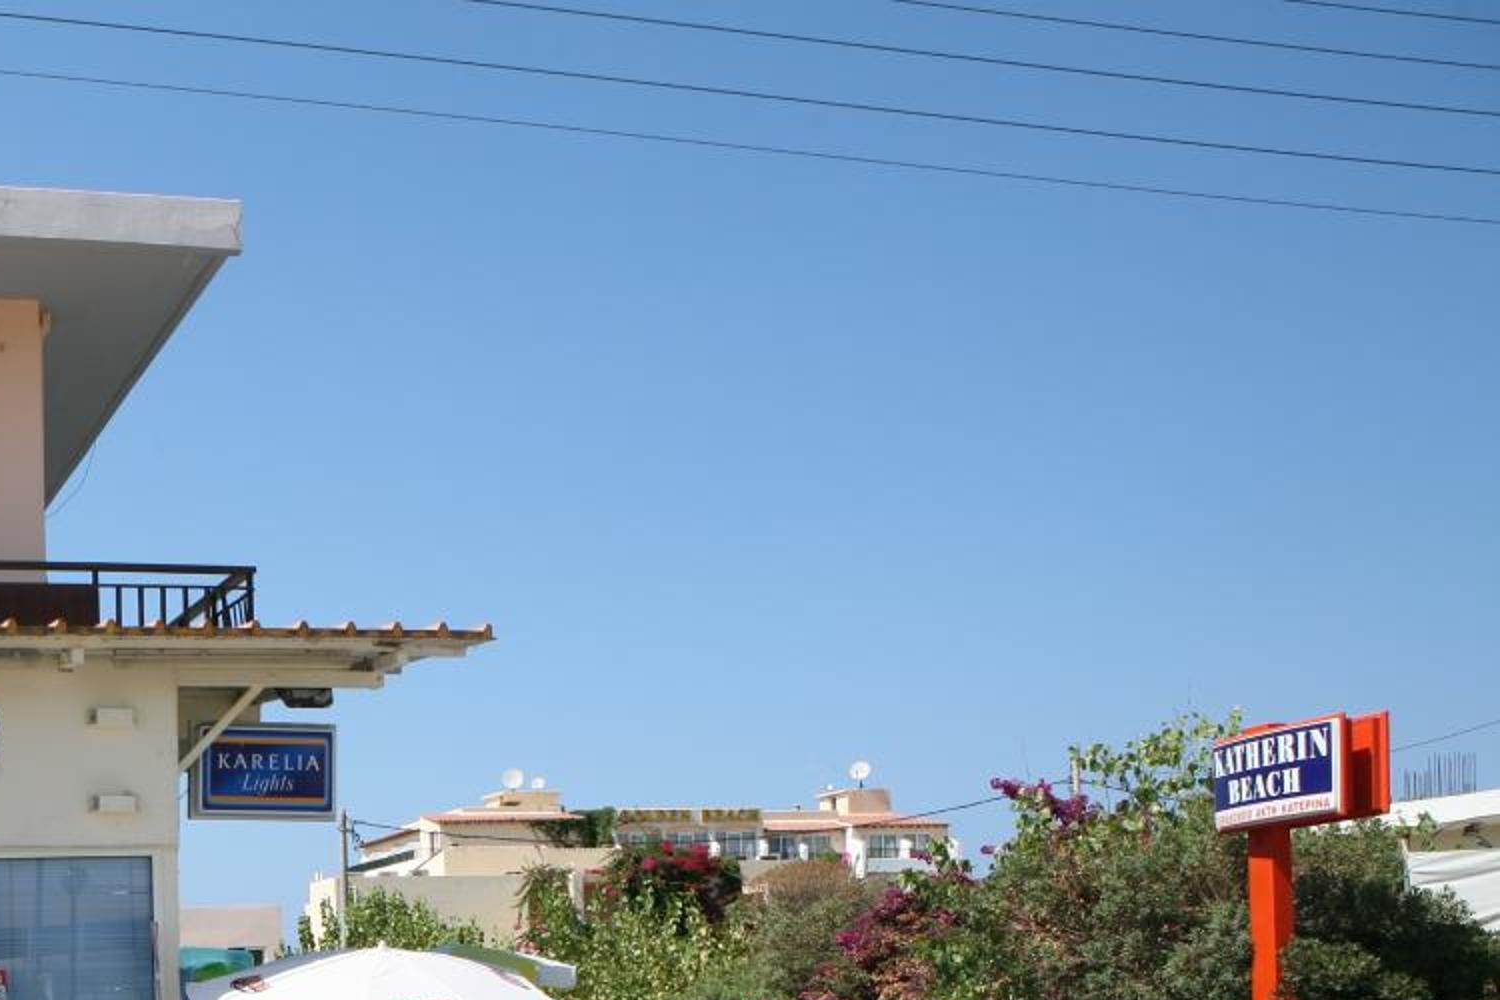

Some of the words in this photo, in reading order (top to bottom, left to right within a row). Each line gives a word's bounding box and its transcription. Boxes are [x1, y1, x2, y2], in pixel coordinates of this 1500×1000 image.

[217, 753, 321, 772] KARELIA
[1214, 727, 1328, 778] KATHERIN
[241, 772, 295, 795] Lights
[1227, 767, 1301, 805] BEACH
